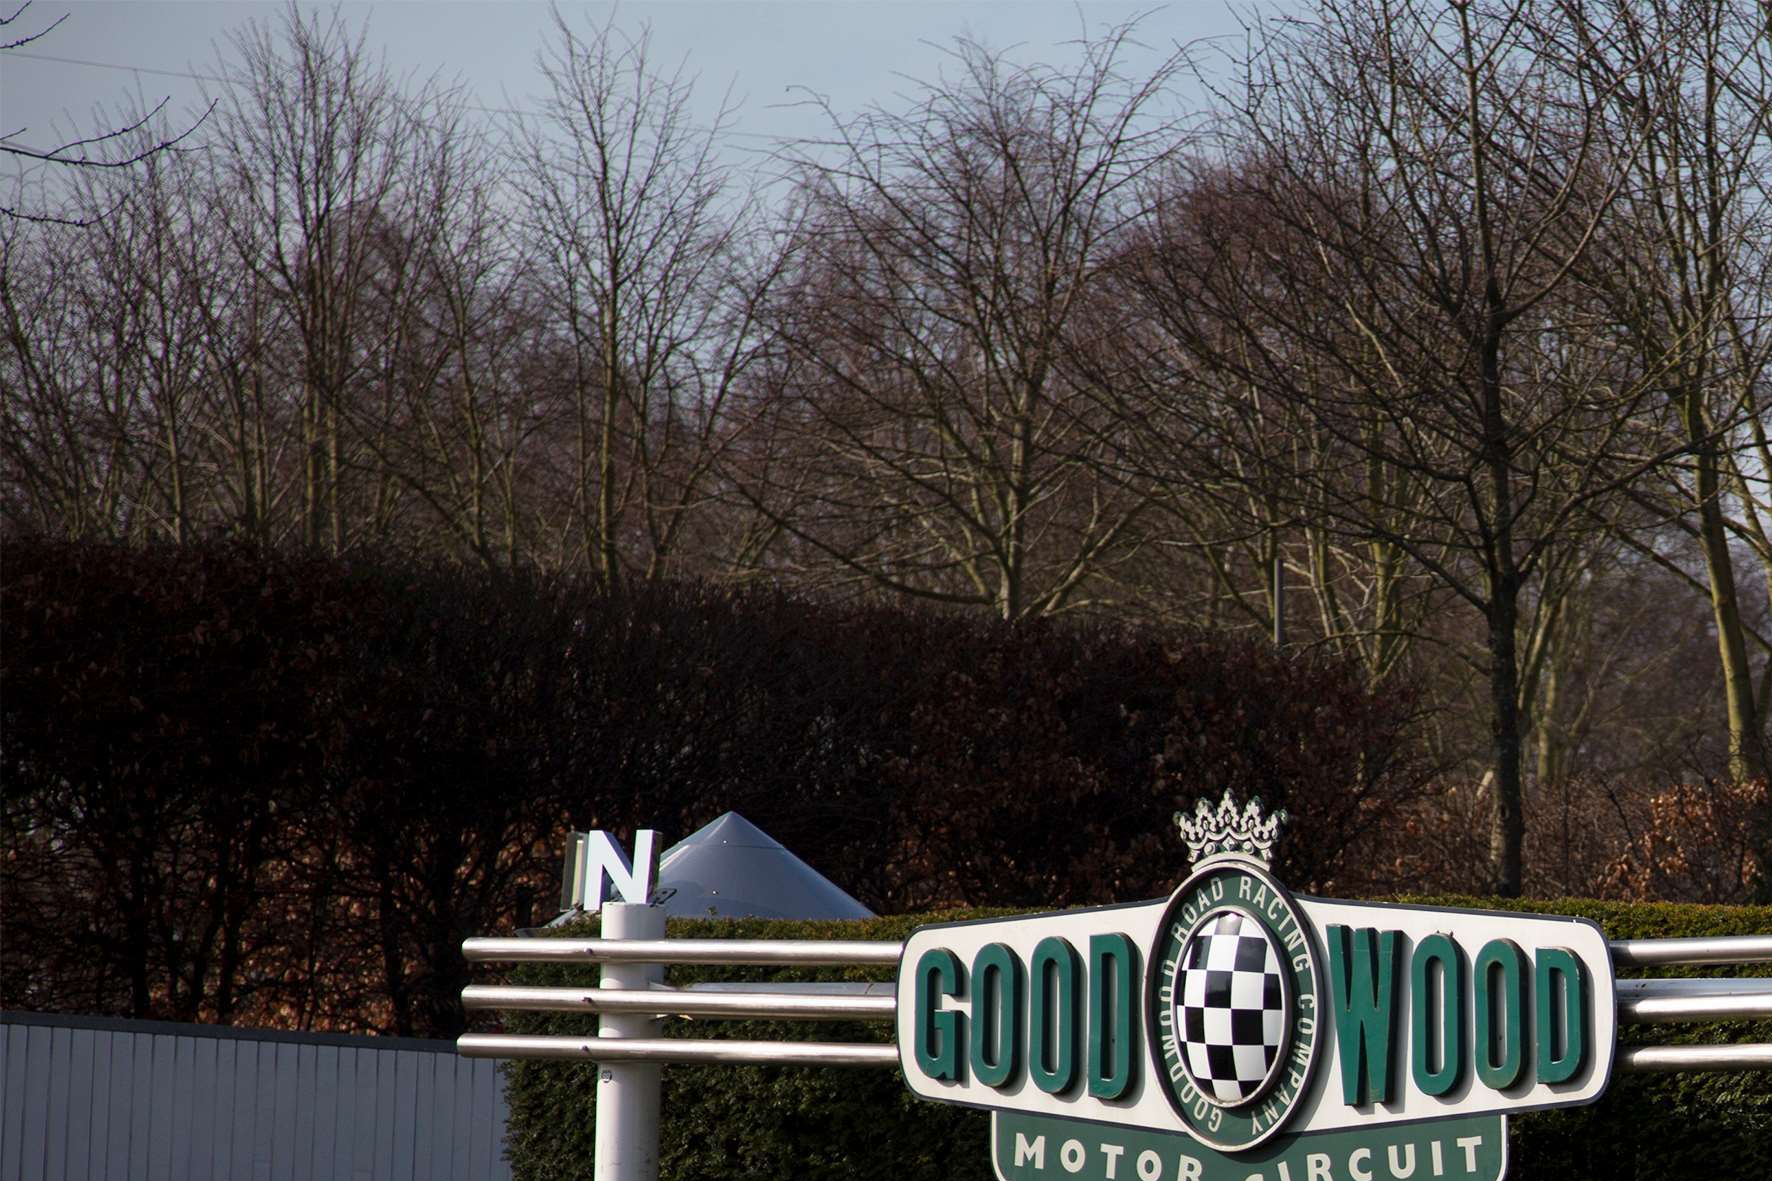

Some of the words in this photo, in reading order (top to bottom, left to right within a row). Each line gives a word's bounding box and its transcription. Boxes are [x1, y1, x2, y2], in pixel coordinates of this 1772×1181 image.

[561, 829, 660, 911] IN
[1171, 876, 1224, 946] ROAD
[1238, 875, 1311, 973] RACING
[914, 931, 1138, 1100] GOOD
[1326, 923, 1589, 1106] WOOD
[1159, 960, 1223, 1132] GOODWOOD
[1251, 993, 1315, 1136] COMPANY
